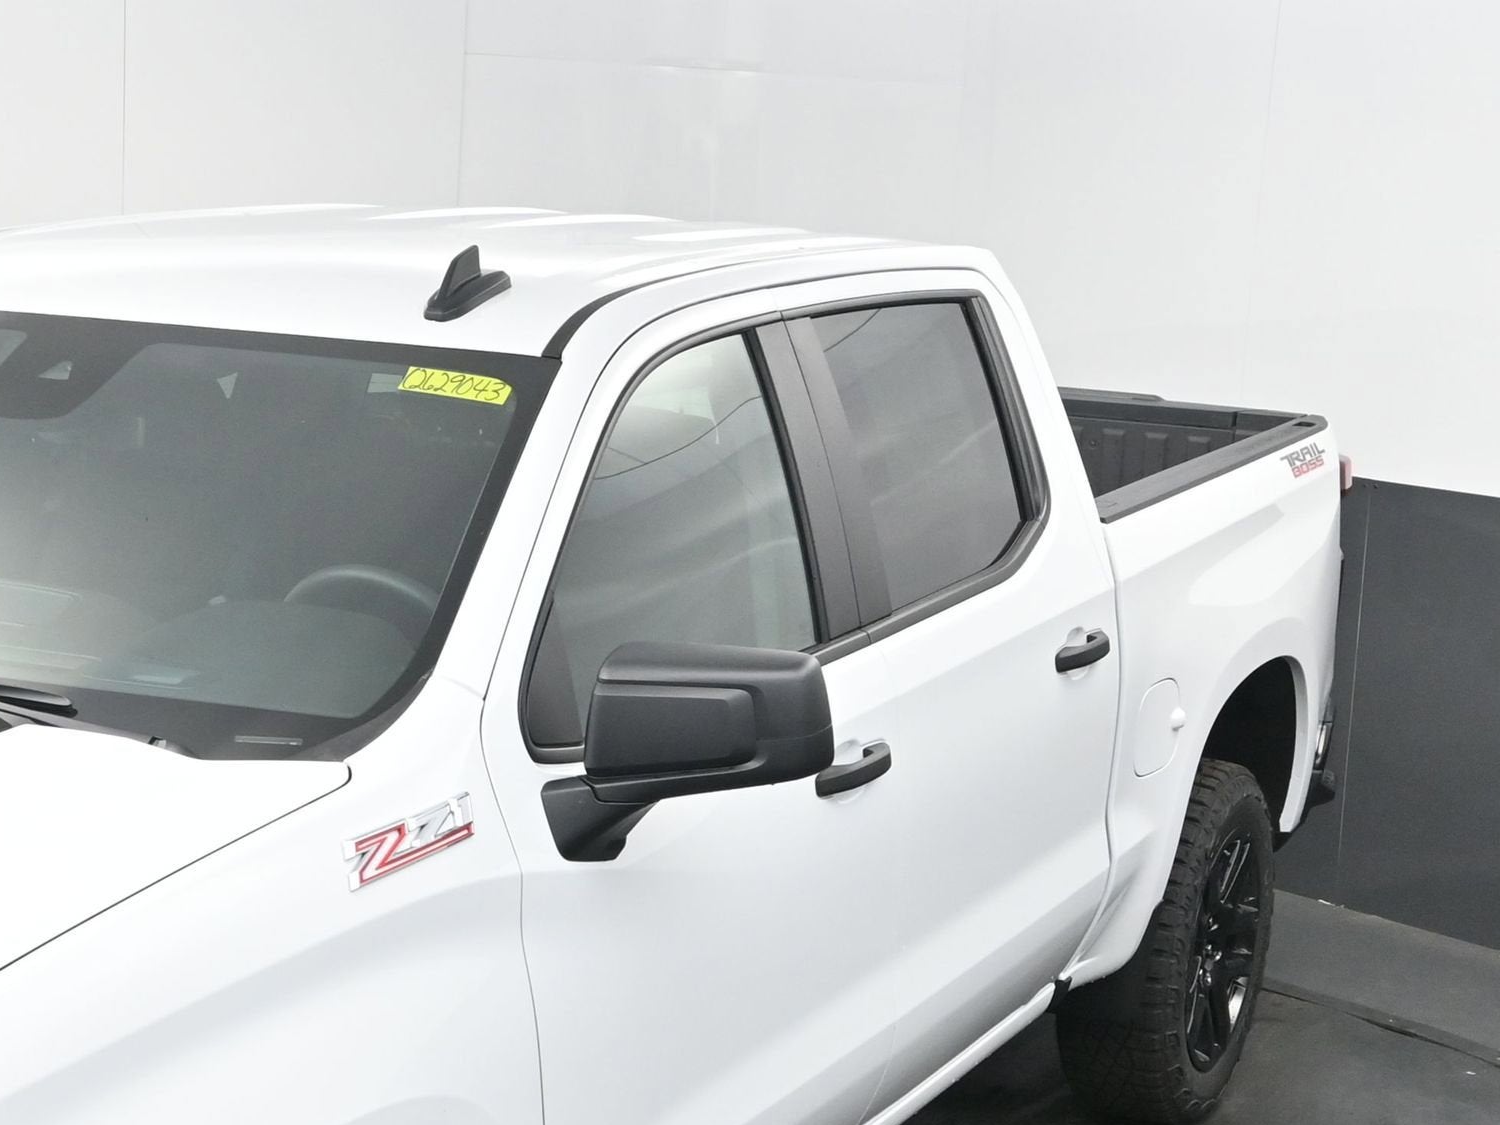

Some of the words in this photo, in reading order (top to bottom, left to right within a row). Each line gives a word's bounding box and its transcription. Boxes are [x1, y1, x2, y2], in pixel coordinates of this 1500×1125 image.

[1280, 442, 1326, 468] TRAIL
[1291, 455, 1324, 478] BOSS
[342, 791, 474, 892] Z71
